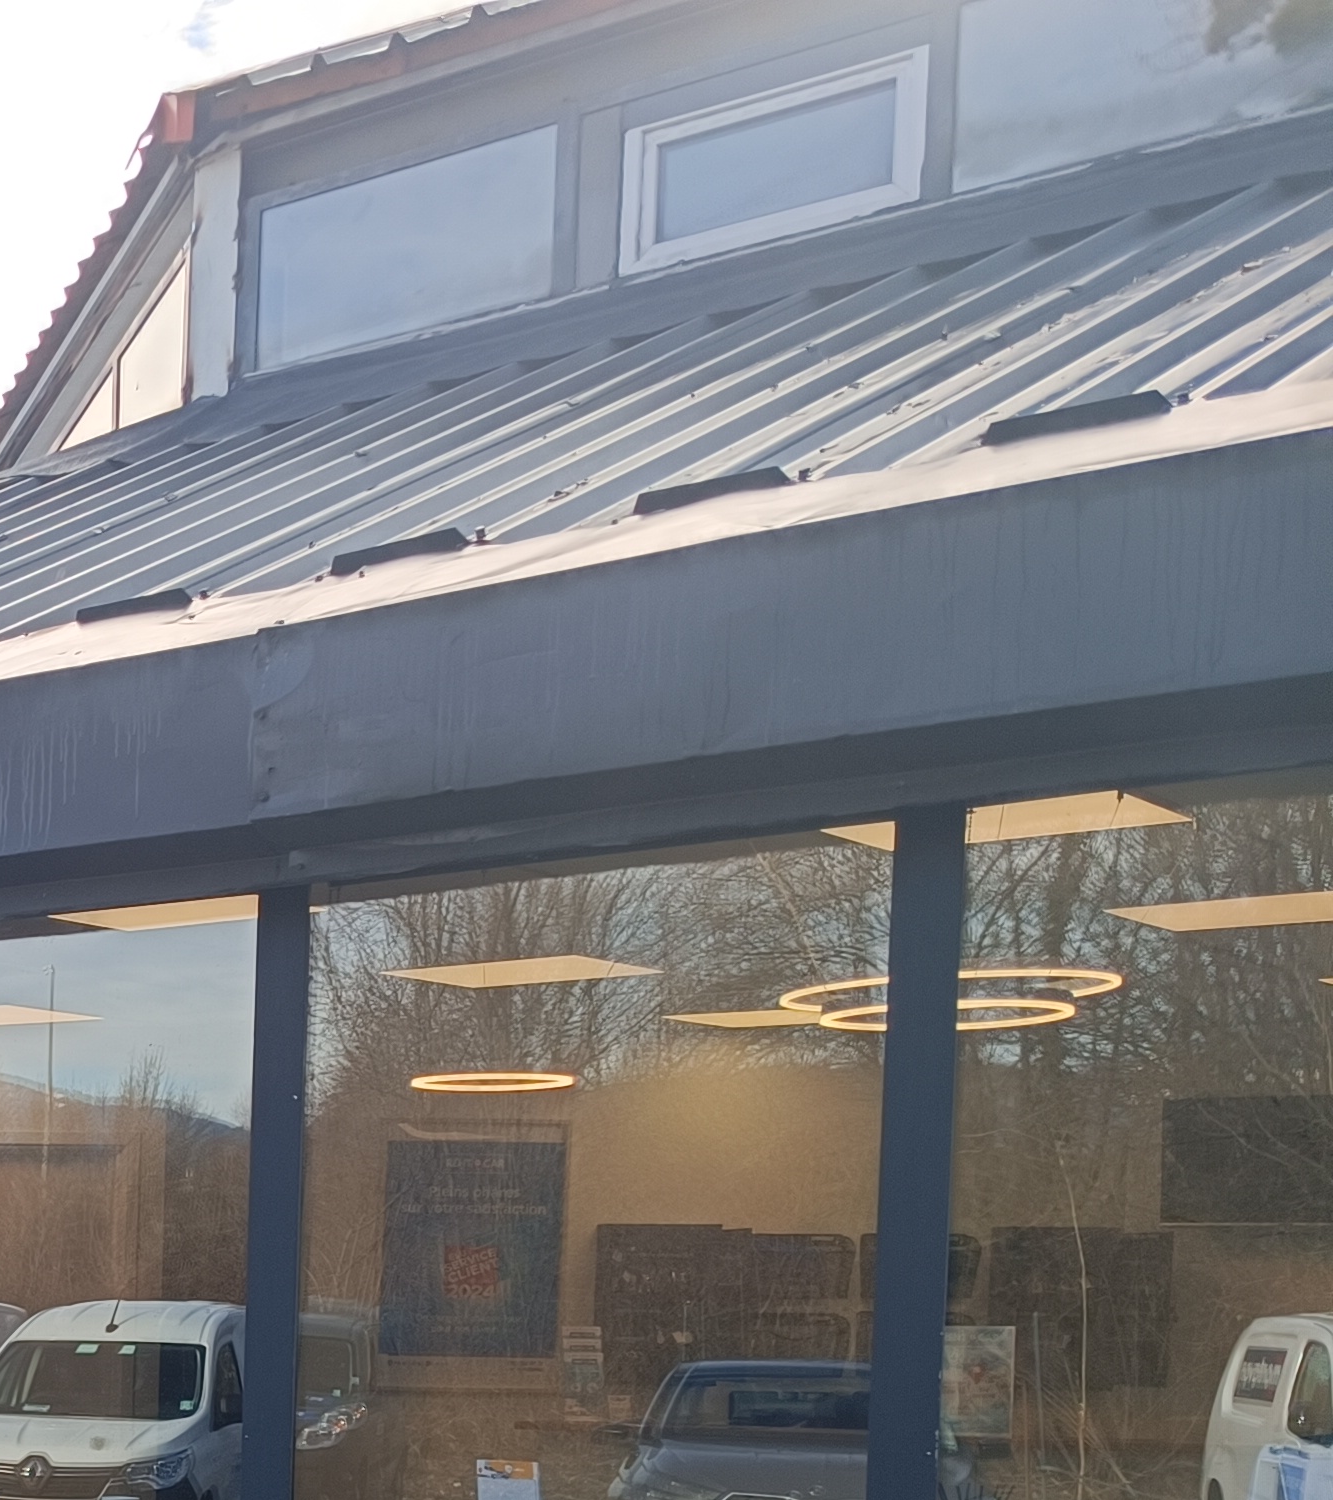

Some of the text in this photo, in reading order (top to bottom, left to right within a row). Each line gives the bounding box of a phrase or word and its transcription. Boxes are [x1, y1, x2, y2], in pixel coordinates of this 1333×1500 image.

[445, 1248, 498, 1272] SERVICE
[447, 1258, 499, 1284] CLIENT
[447, 1283, 496, 1298] 2024
